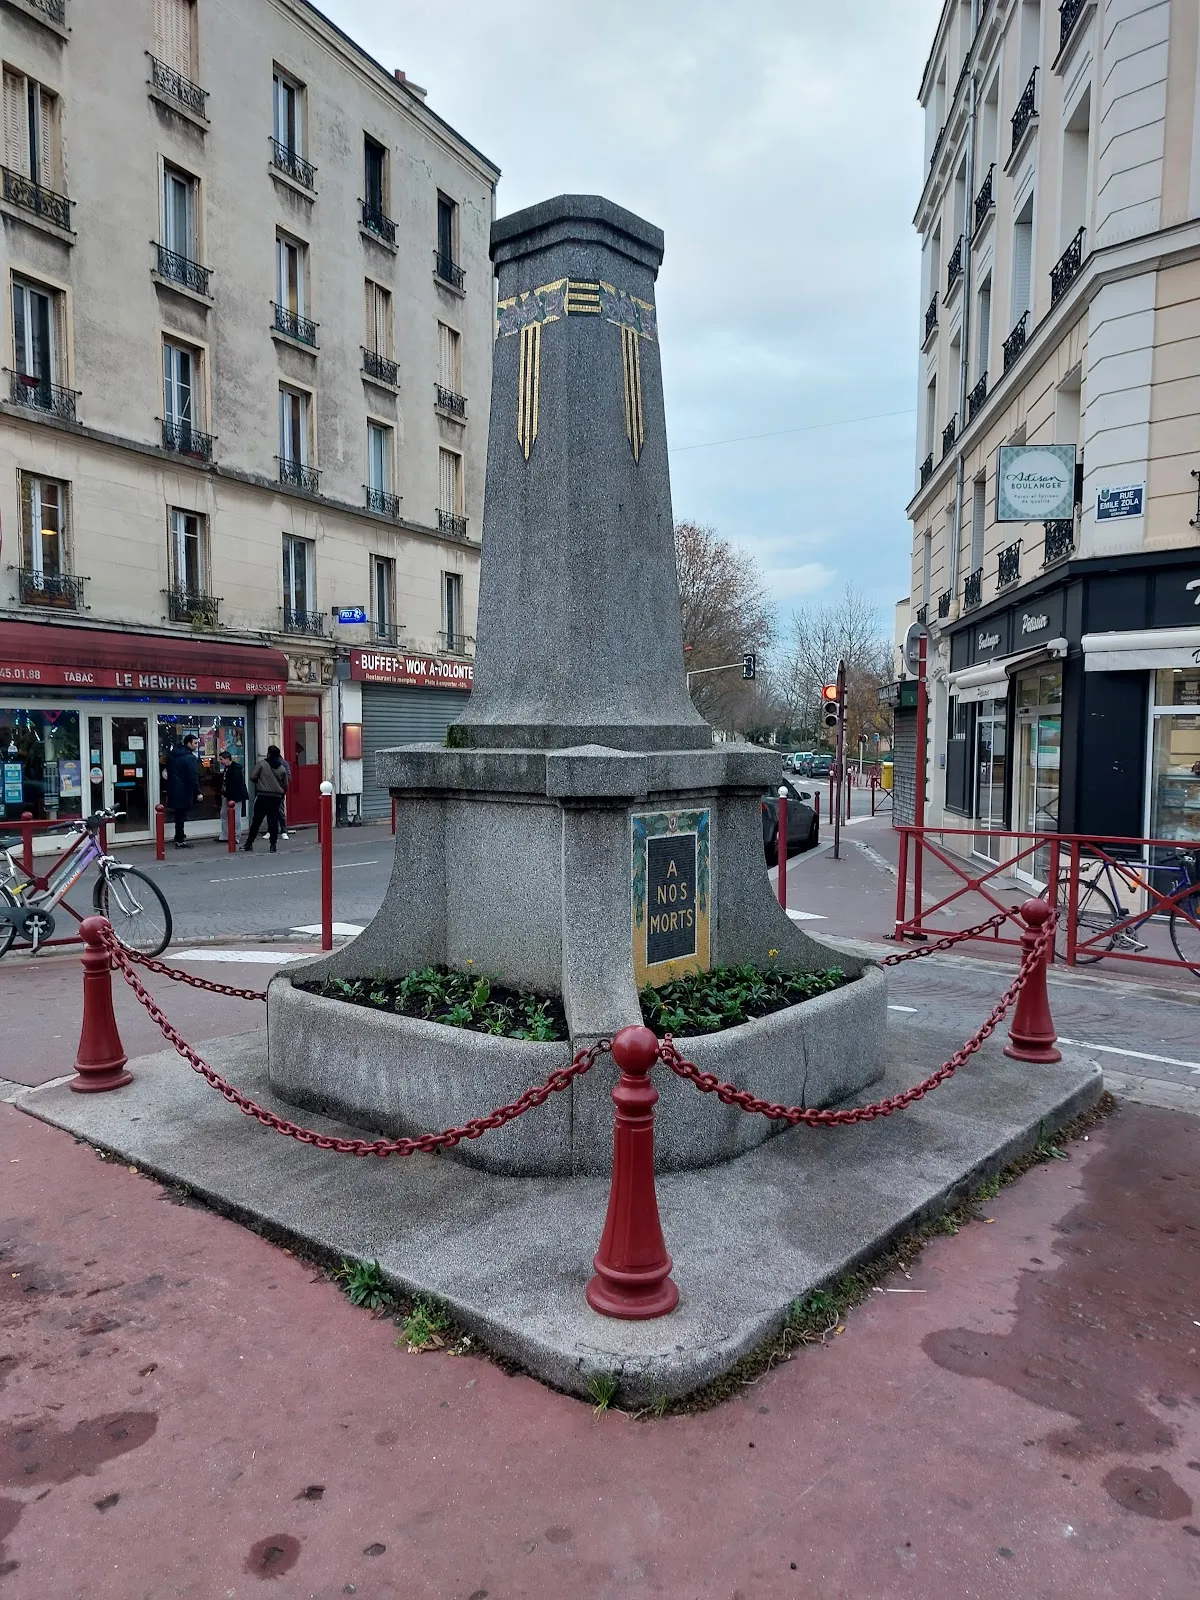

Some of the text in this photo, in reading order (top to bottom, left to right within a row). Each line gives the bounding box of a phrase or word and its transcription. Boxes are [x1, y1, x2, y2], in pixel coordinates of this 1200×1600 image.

[1005, 472, 1068, 482] Artisan
[1011, 482, 1062, 490] BOULANGER
[1119, 490, 1135, 500] RUE
[1099, 497, 1139, 510] EMILE ZOLA
[361, 653, 397, 673] BUFFET
[406, 659, 427, 676] WOK
[437, 664, 474, 680] VOLONTE
[63, 671, 94, 683] TABAC
[115, 671, 133, 687] LE
[215, 680, 282, 693] BAR BRASSERIE
[667, 860, 677, 878] A
[657, 882, 687, 904] NOS
[650, 909, 693, 934] MORTS
